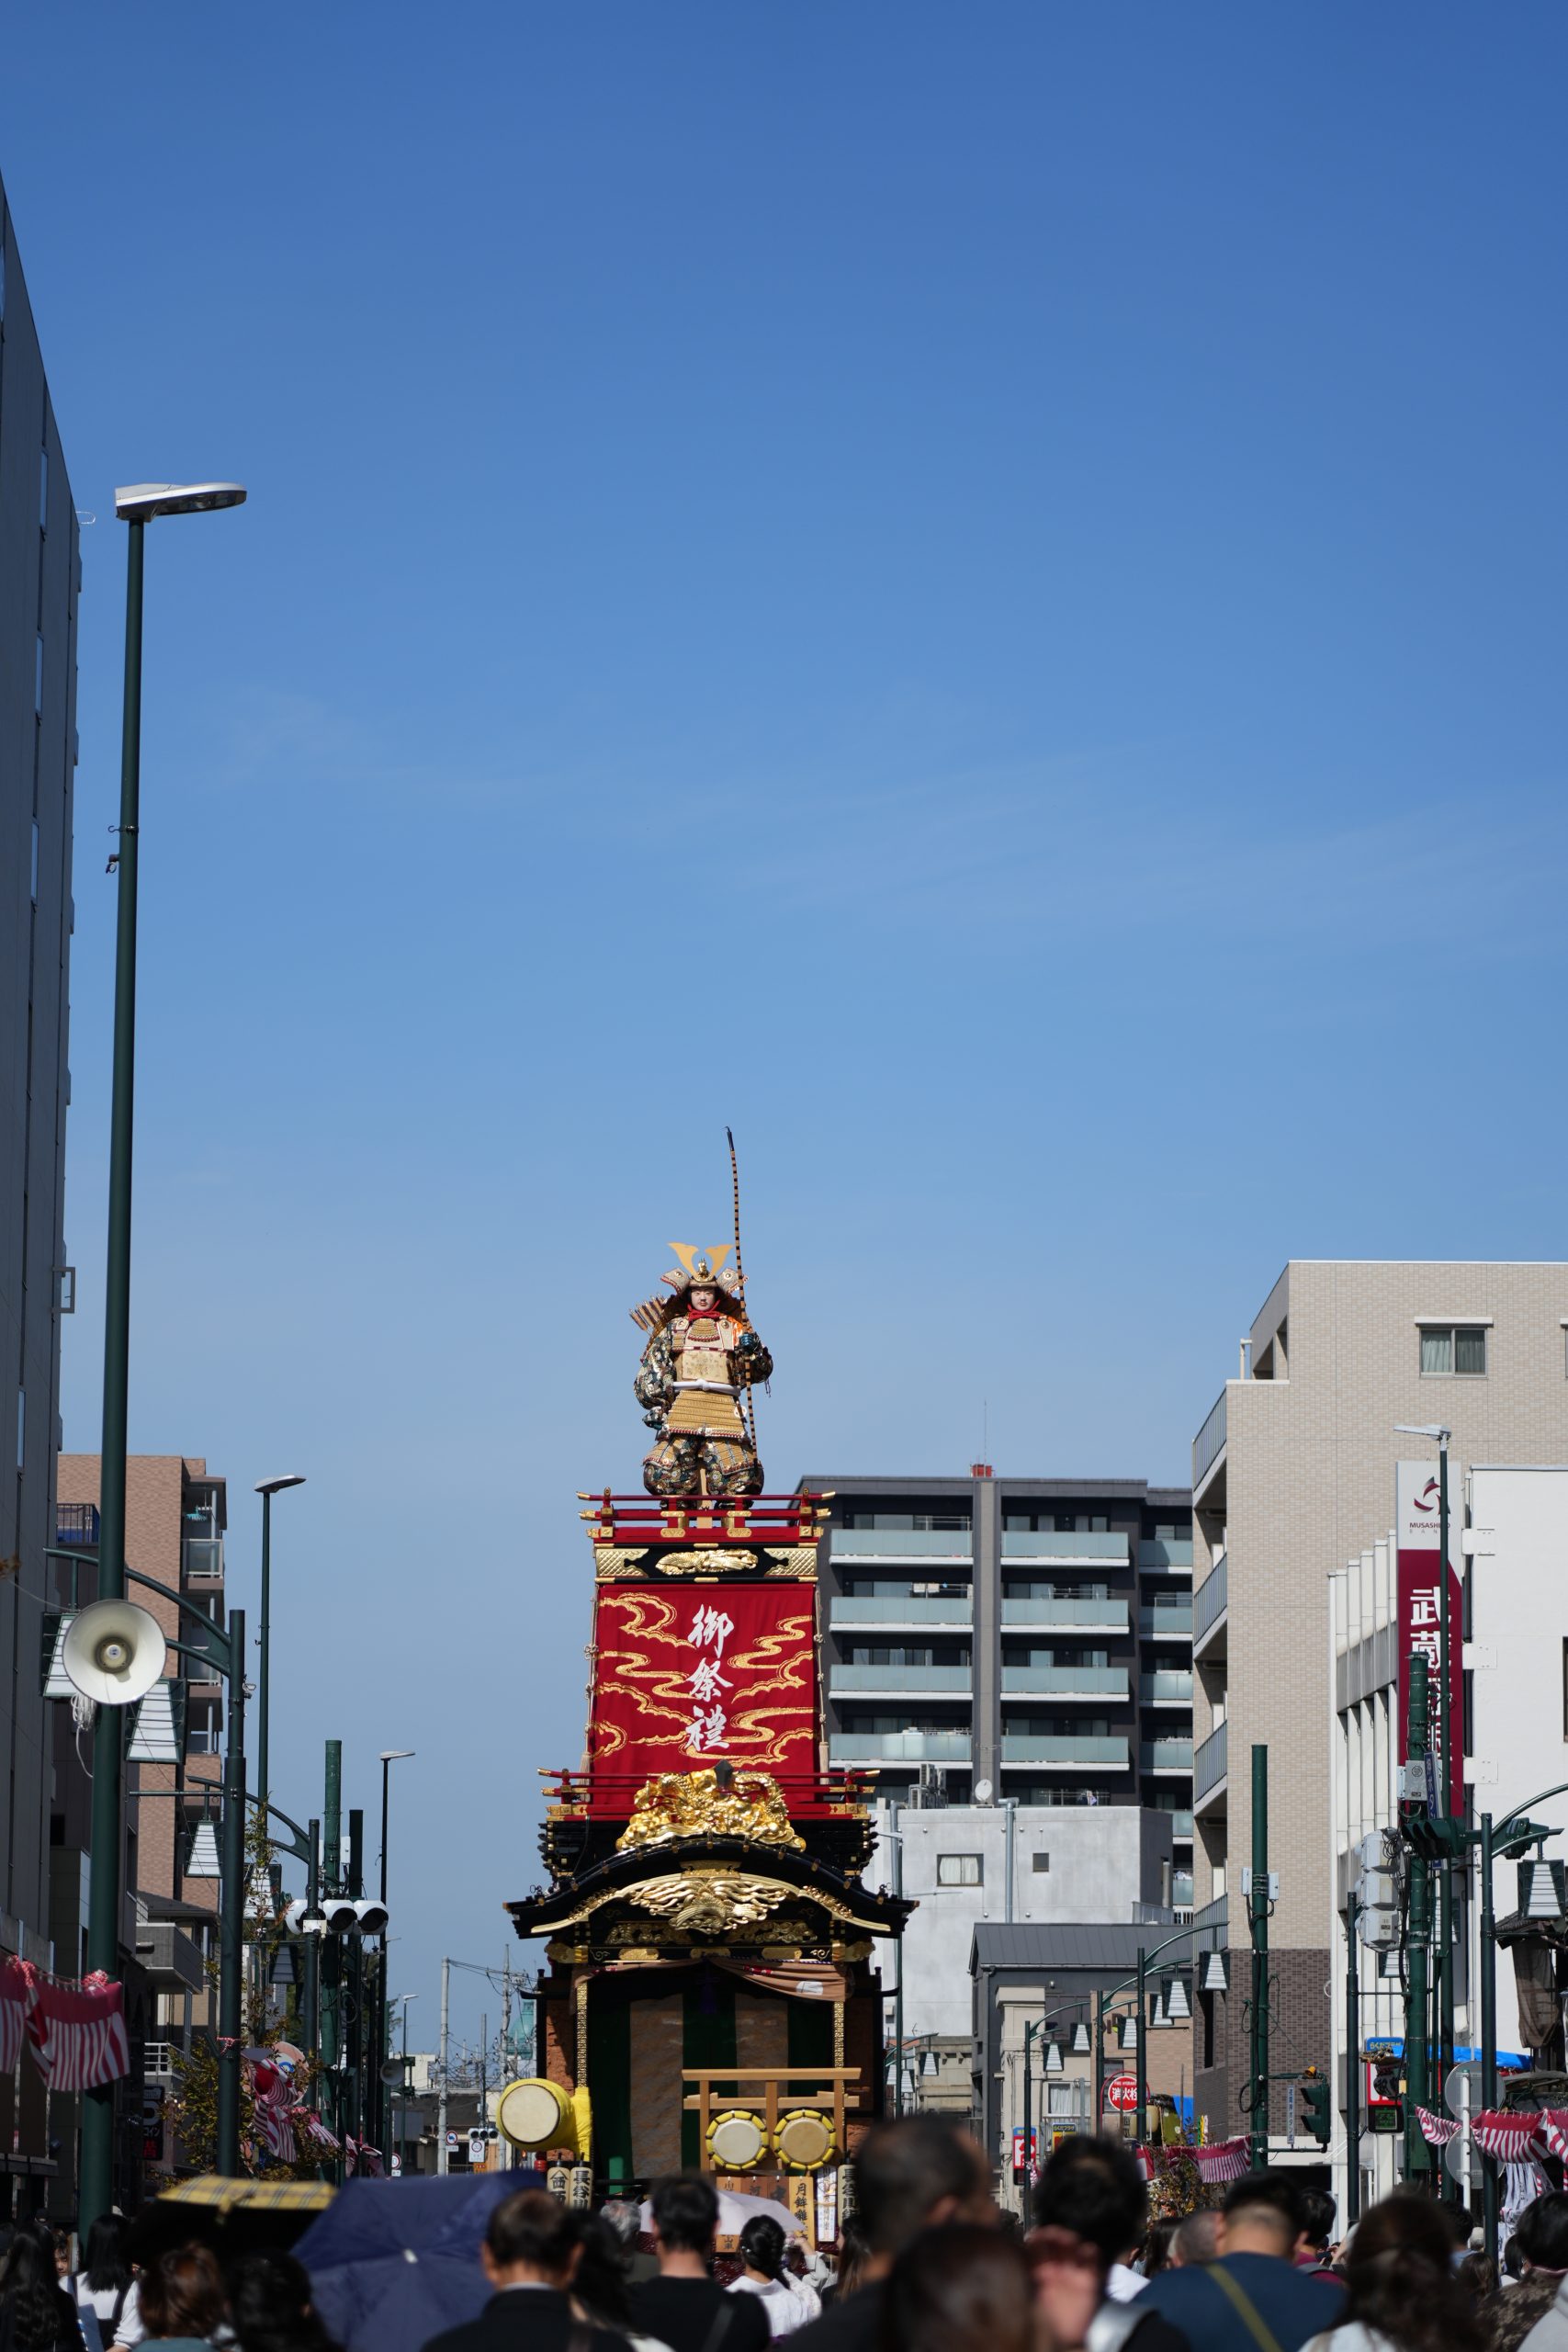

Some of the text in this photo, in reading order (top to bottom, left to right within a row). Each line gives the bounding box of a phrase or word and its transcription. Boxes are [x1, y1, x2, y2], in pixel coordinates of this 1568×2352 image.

[685, 1604, 734, 1751] 御祭禮
[1111, 2087, 1138, 2101] 消火栓
